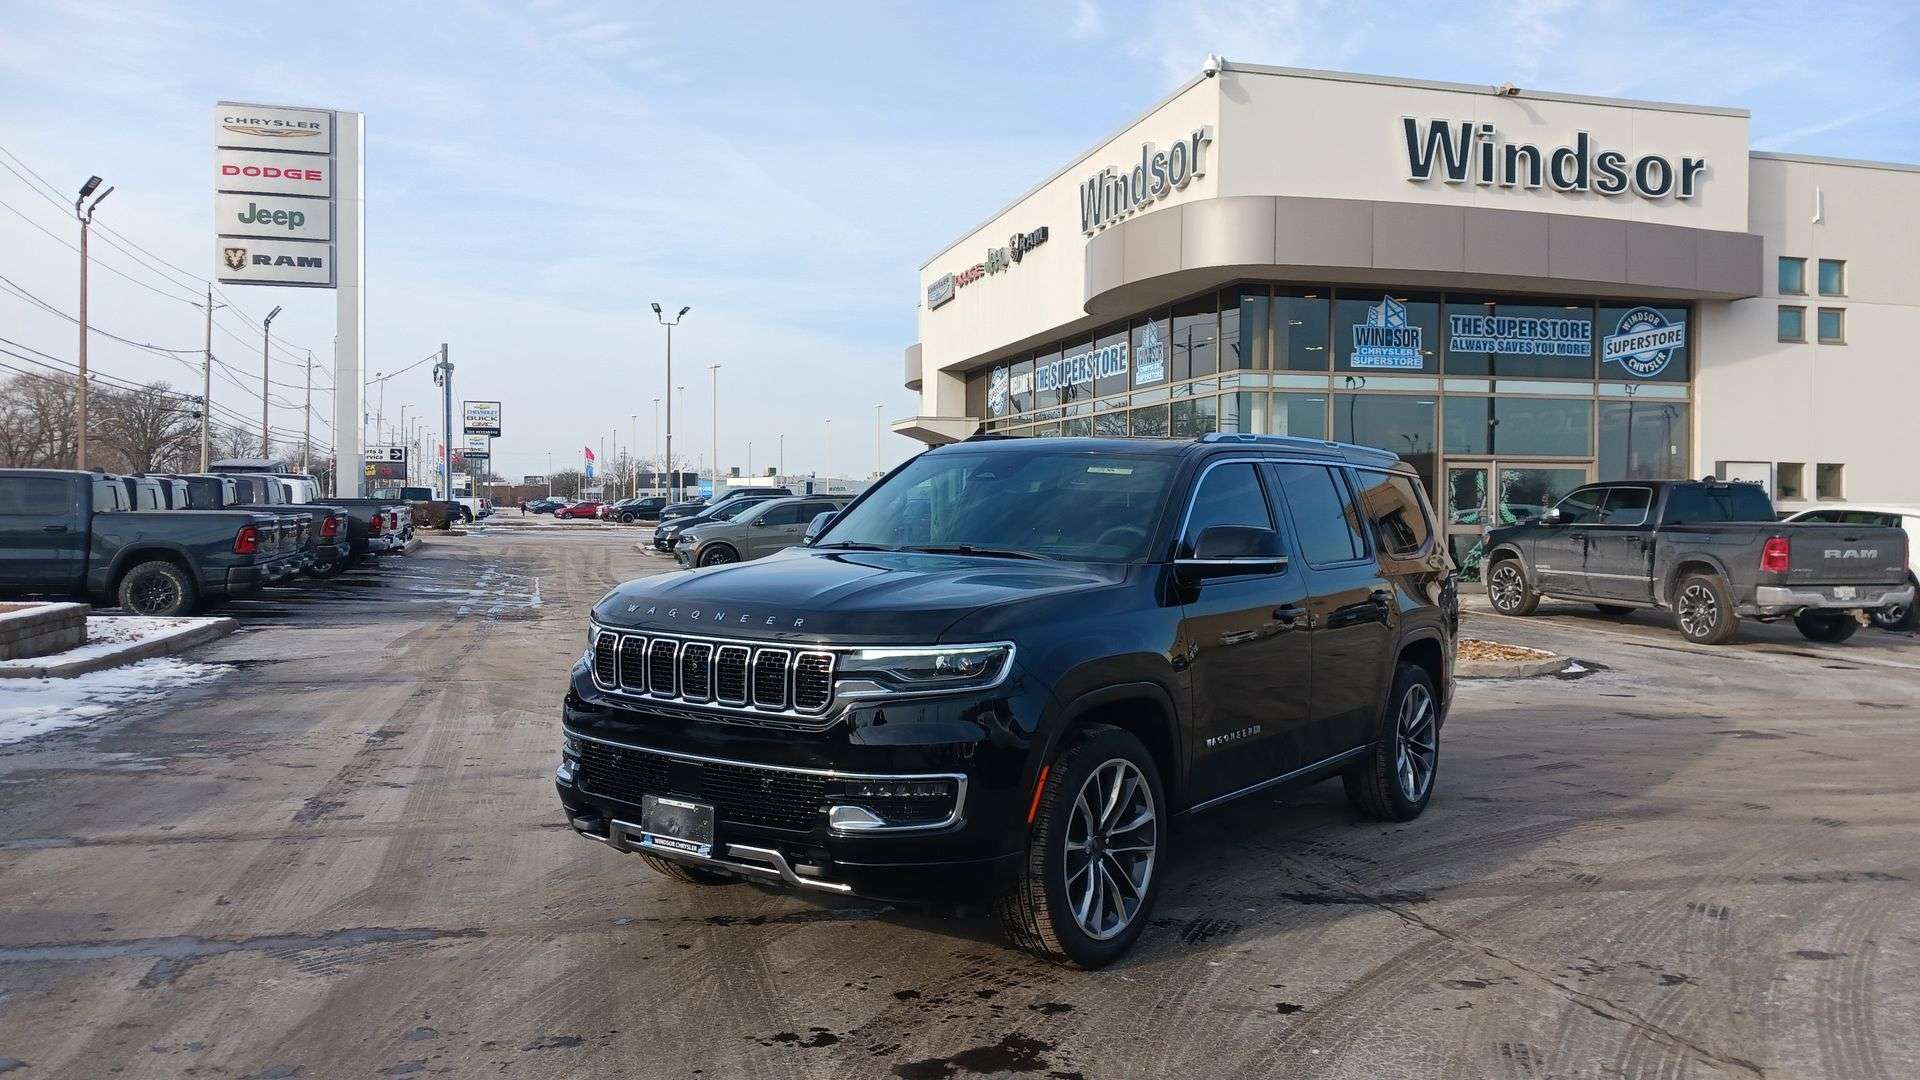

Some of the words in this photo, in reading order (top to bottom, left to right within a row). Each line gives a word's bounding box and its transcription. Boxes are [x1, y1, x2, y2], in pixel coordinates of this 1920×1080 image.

[224, 116, 321, 129] CHRYSLER
[1400, 115, 1705, 199] Windsor
[222, 165, 322, 181] DODGE
[1080, 126, 1211, 235] Windsor
[238, 203, 305, 230] Jeep
[252, 254, 322, 268] RAM
[1451, 317, 1481, 335] THE
[1485, 317, 1590, 339] SUPERSTORE
[1622, 312, 1660, 331] WINDSOR
[1355, 327, 1419, 347] WINDSOR
[1607, 330, 1681, 355] SUPERSTORE
[1361, 347, 1414, 356] CHRYSLER
[1452, 340, 1495, 352] ALWAYS
[1497, 341, 1534, 353] SAVES
[1535, 341, 1555, 354] YOU
[1556, 342, 1590, 355] MORE!
[1036, 367, 1049, 391] THE
[1050, 344, 1128, 388] SUPERSTORE
[1354, 356, 1420, 366] SUPERSTORE
[1628, 352, 1666, 372] CHRYSLER
[1824, 549, 1879, 559] RAM
[627, 603, 804, 627] WAGONEER
